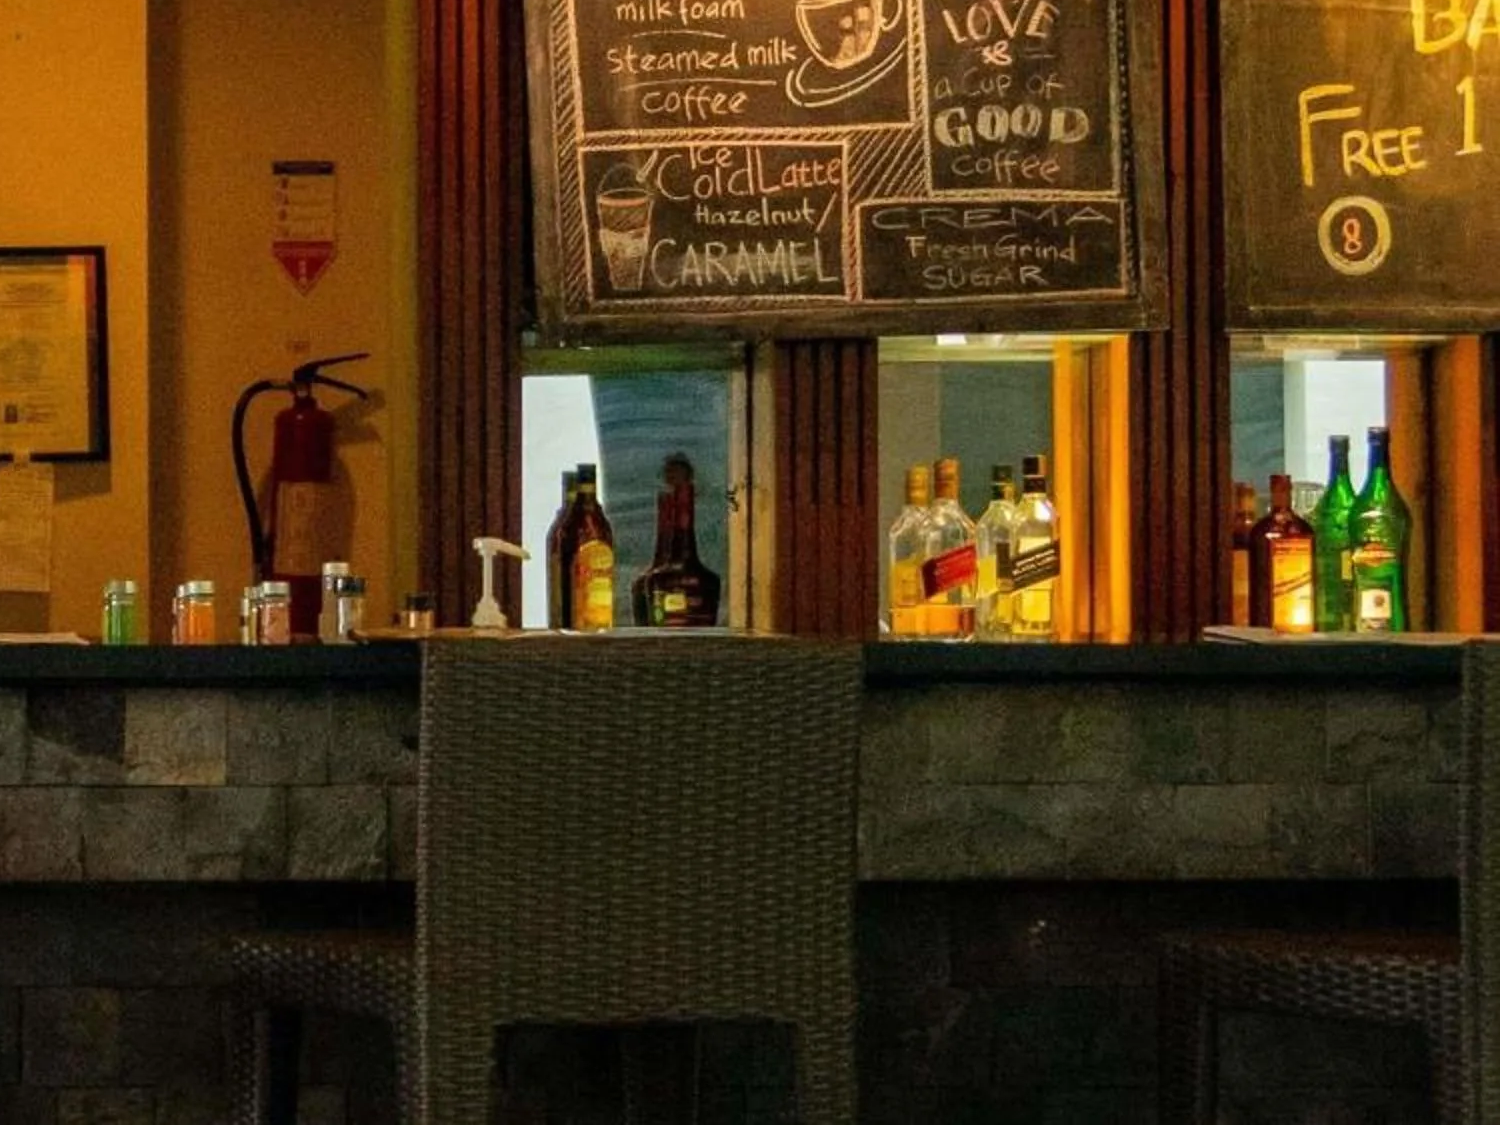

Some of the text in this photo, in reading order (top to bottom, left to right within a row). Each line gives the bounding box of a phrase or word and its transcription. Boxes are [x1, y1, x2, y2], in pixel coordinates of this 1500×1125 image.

[747, 37, 798, 66] milk
[933, 103, 1090, 148] GOOD
[1454, 76, 1484, 157] 1
[656, 146, 843, 201] Cold Latte
[693, 197, 816, 226] Hazelnut
[871, 205, 1114, 230] CREMA
[650, 236, 840, 289] CARAMEL
[921, 264, 1049, 291] SUGAR
